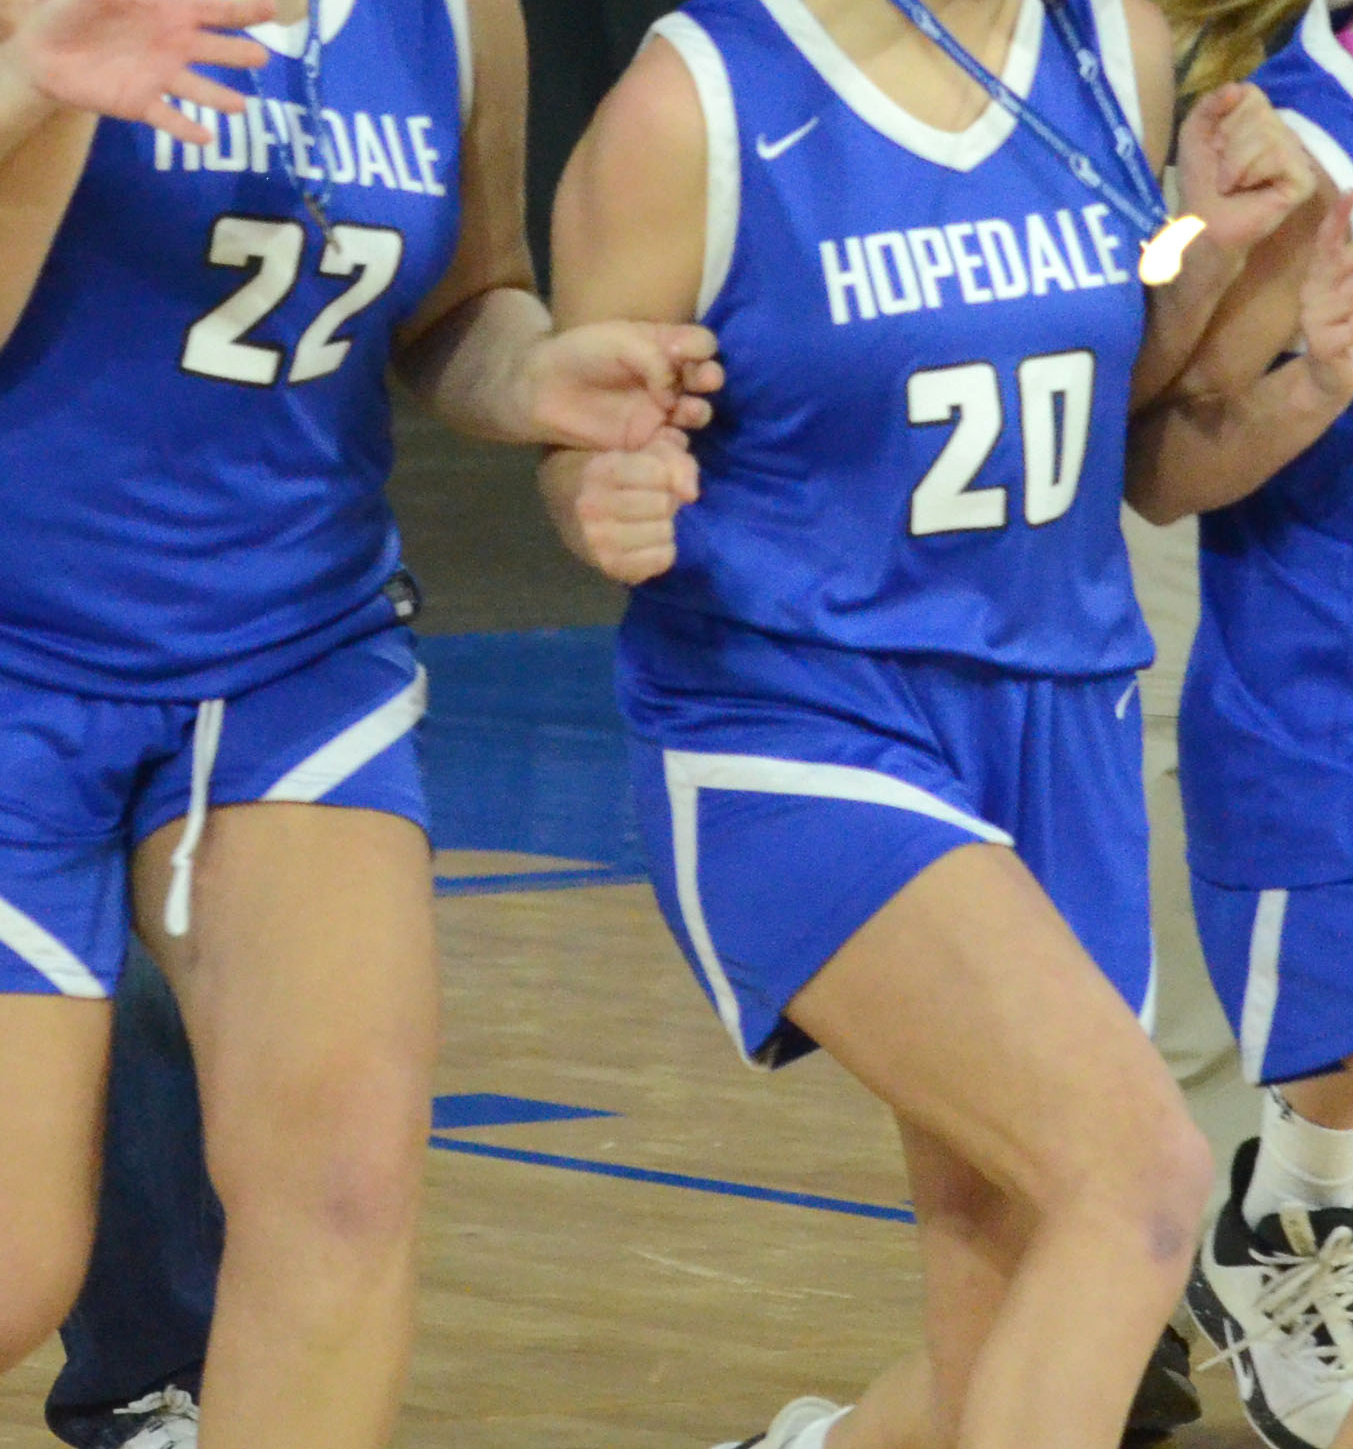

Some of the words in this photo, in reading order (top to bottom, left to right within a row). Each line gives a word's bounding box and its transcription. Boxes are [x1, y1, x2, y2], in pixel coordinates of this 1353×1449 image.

[179, 215, 403, 386] 22
[818, 203, 1131, 325] HOPEDALE
[906, 349, 1094, 537] 20
